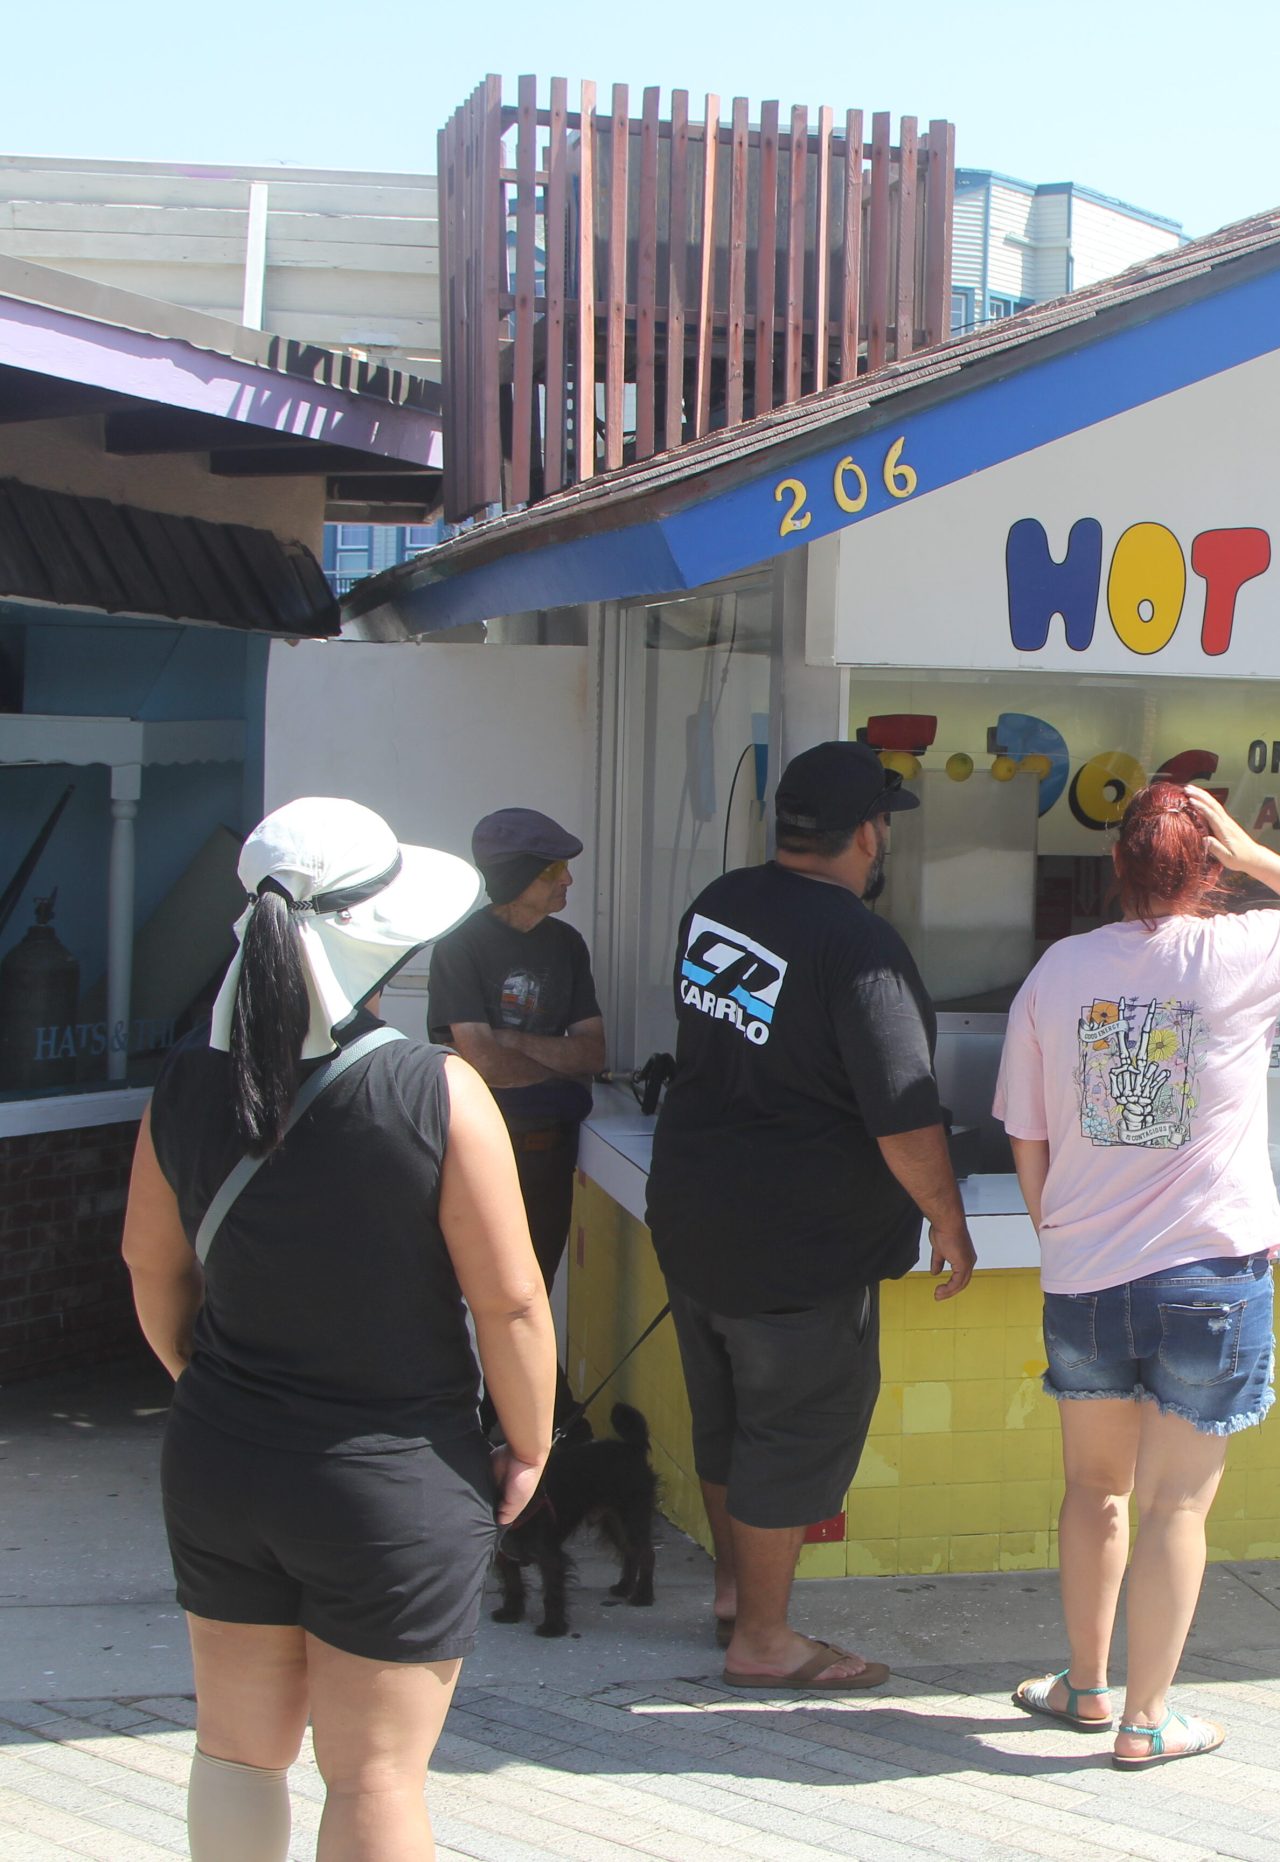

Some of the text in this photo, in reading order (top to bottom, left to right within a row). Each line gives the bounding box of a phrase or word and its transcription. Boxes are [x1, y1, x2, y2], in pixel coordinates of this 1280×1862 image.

[774, 436, 918, 537] 206
[1005, 517, 1272, 656] HOT
[32, 1021, 107, 1061] HATS
[1085, 1022, 1120, 1040] GOOD ENERGY
[1132, 1125, 1168, 1142] CONTAGIOUS
